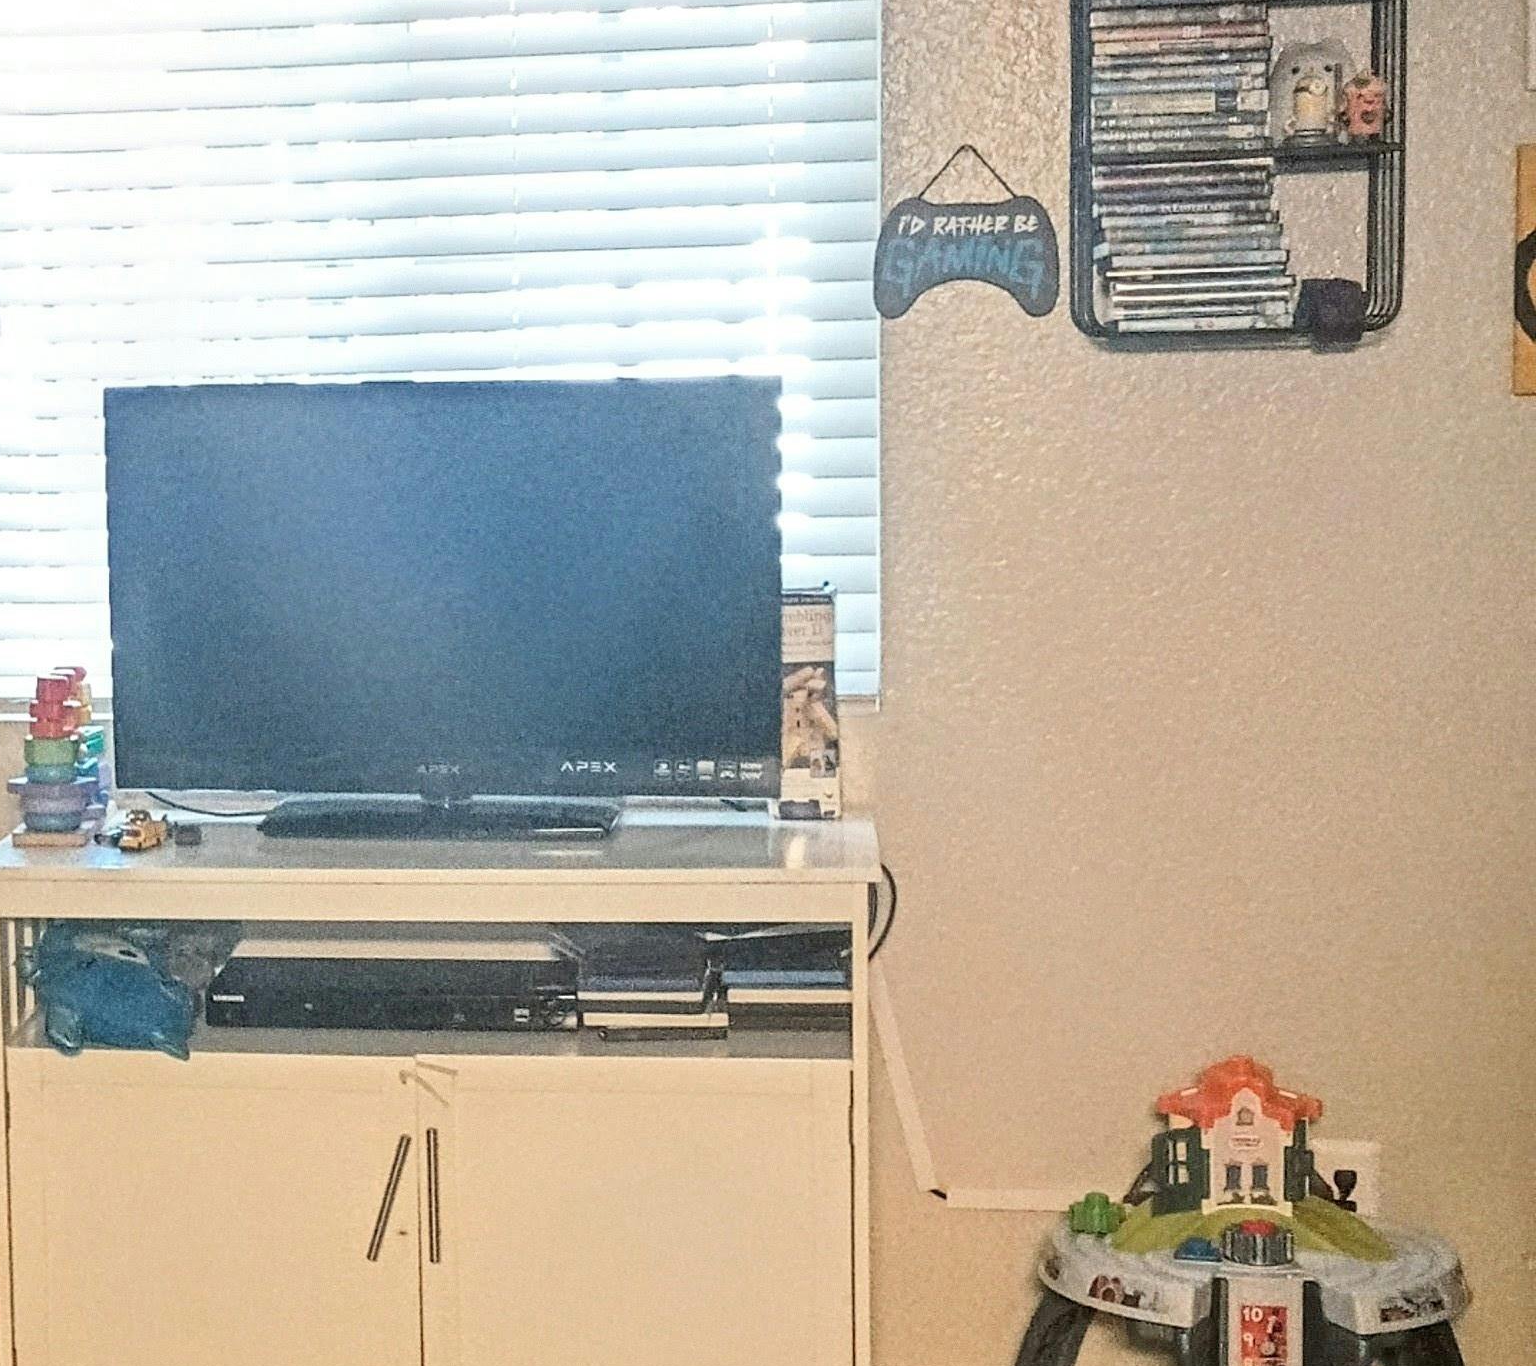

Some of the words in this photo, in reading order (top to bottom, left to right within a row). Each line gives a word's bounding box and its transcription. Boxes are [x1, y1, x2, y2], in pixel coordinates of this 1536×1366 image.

[933, 215, 1008, 235] RATHER
[1014, 215, 1039, 233] BE
[882, 237, 1045, 300] GAMING
[560, 761, 617, 774] APEX
[1243, 1307, 1263, 1323] 10
[1244, 1334, 1254, 1348] 9
